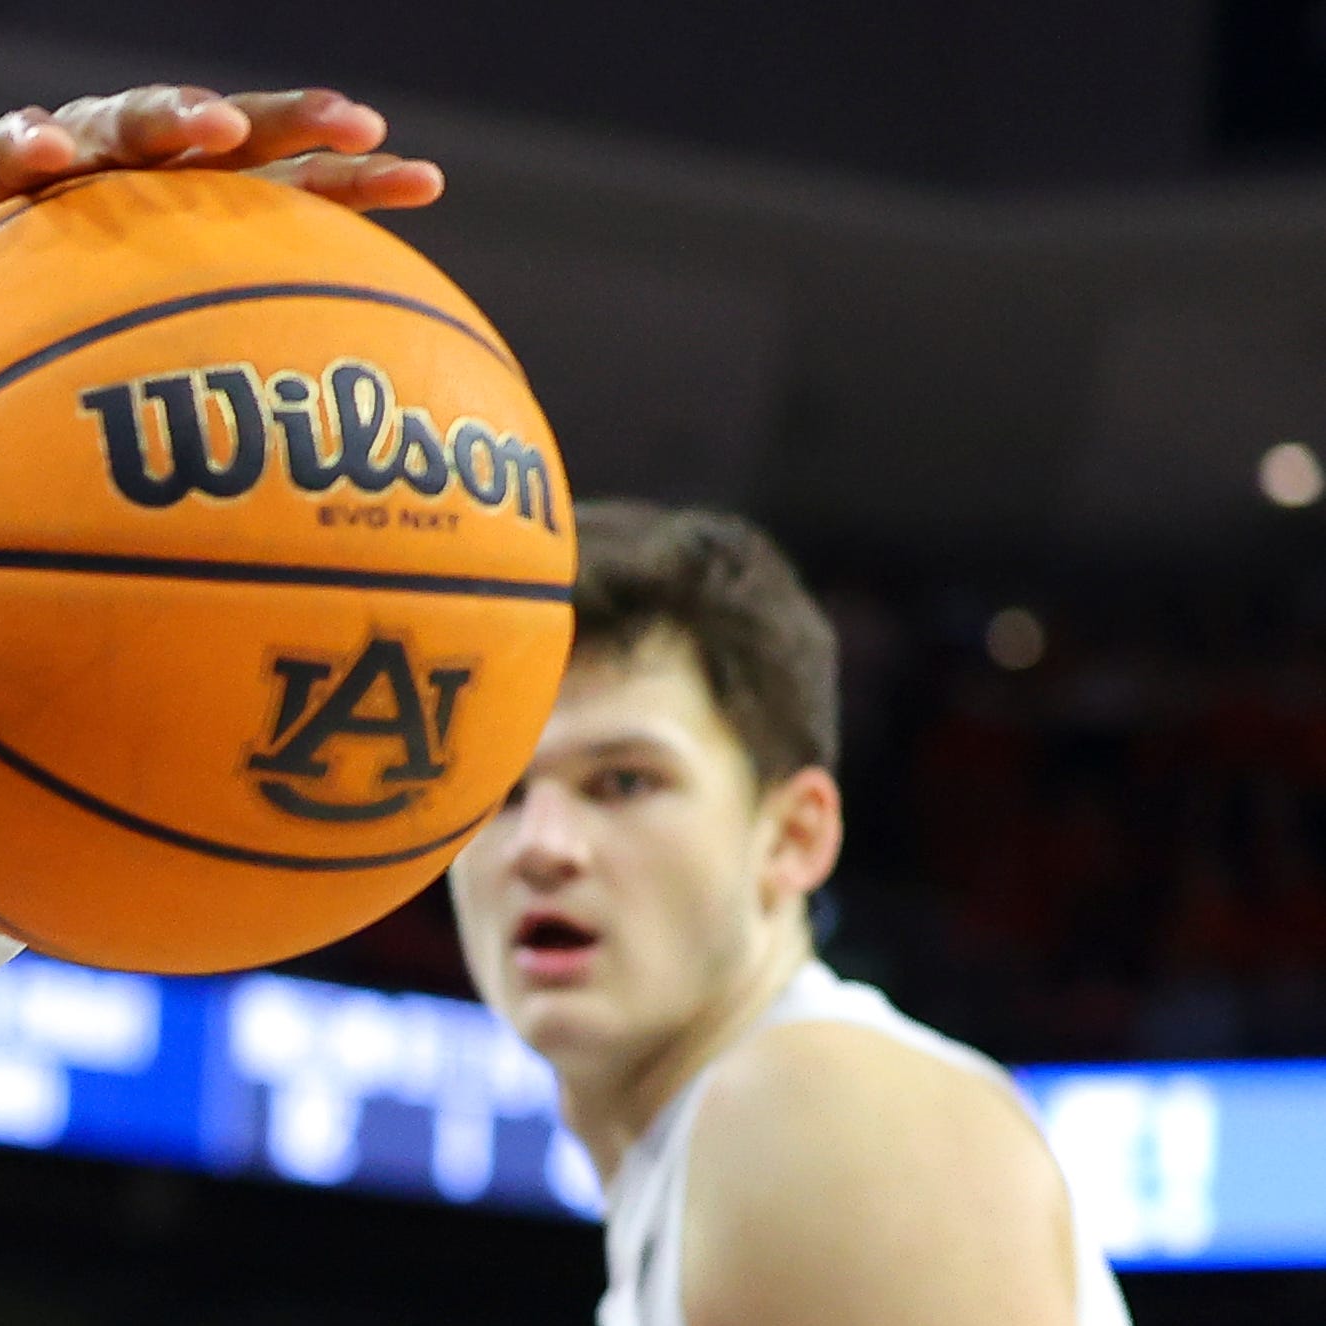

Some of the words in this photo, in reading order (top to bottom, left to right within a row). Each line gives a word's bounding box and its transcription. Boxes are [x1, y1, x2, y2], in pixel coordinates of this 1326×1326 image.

[77, 357, 560, 537] Wilson
[317, 506, 390, 530] EVO
[398, 508, 461, 534] NXT
